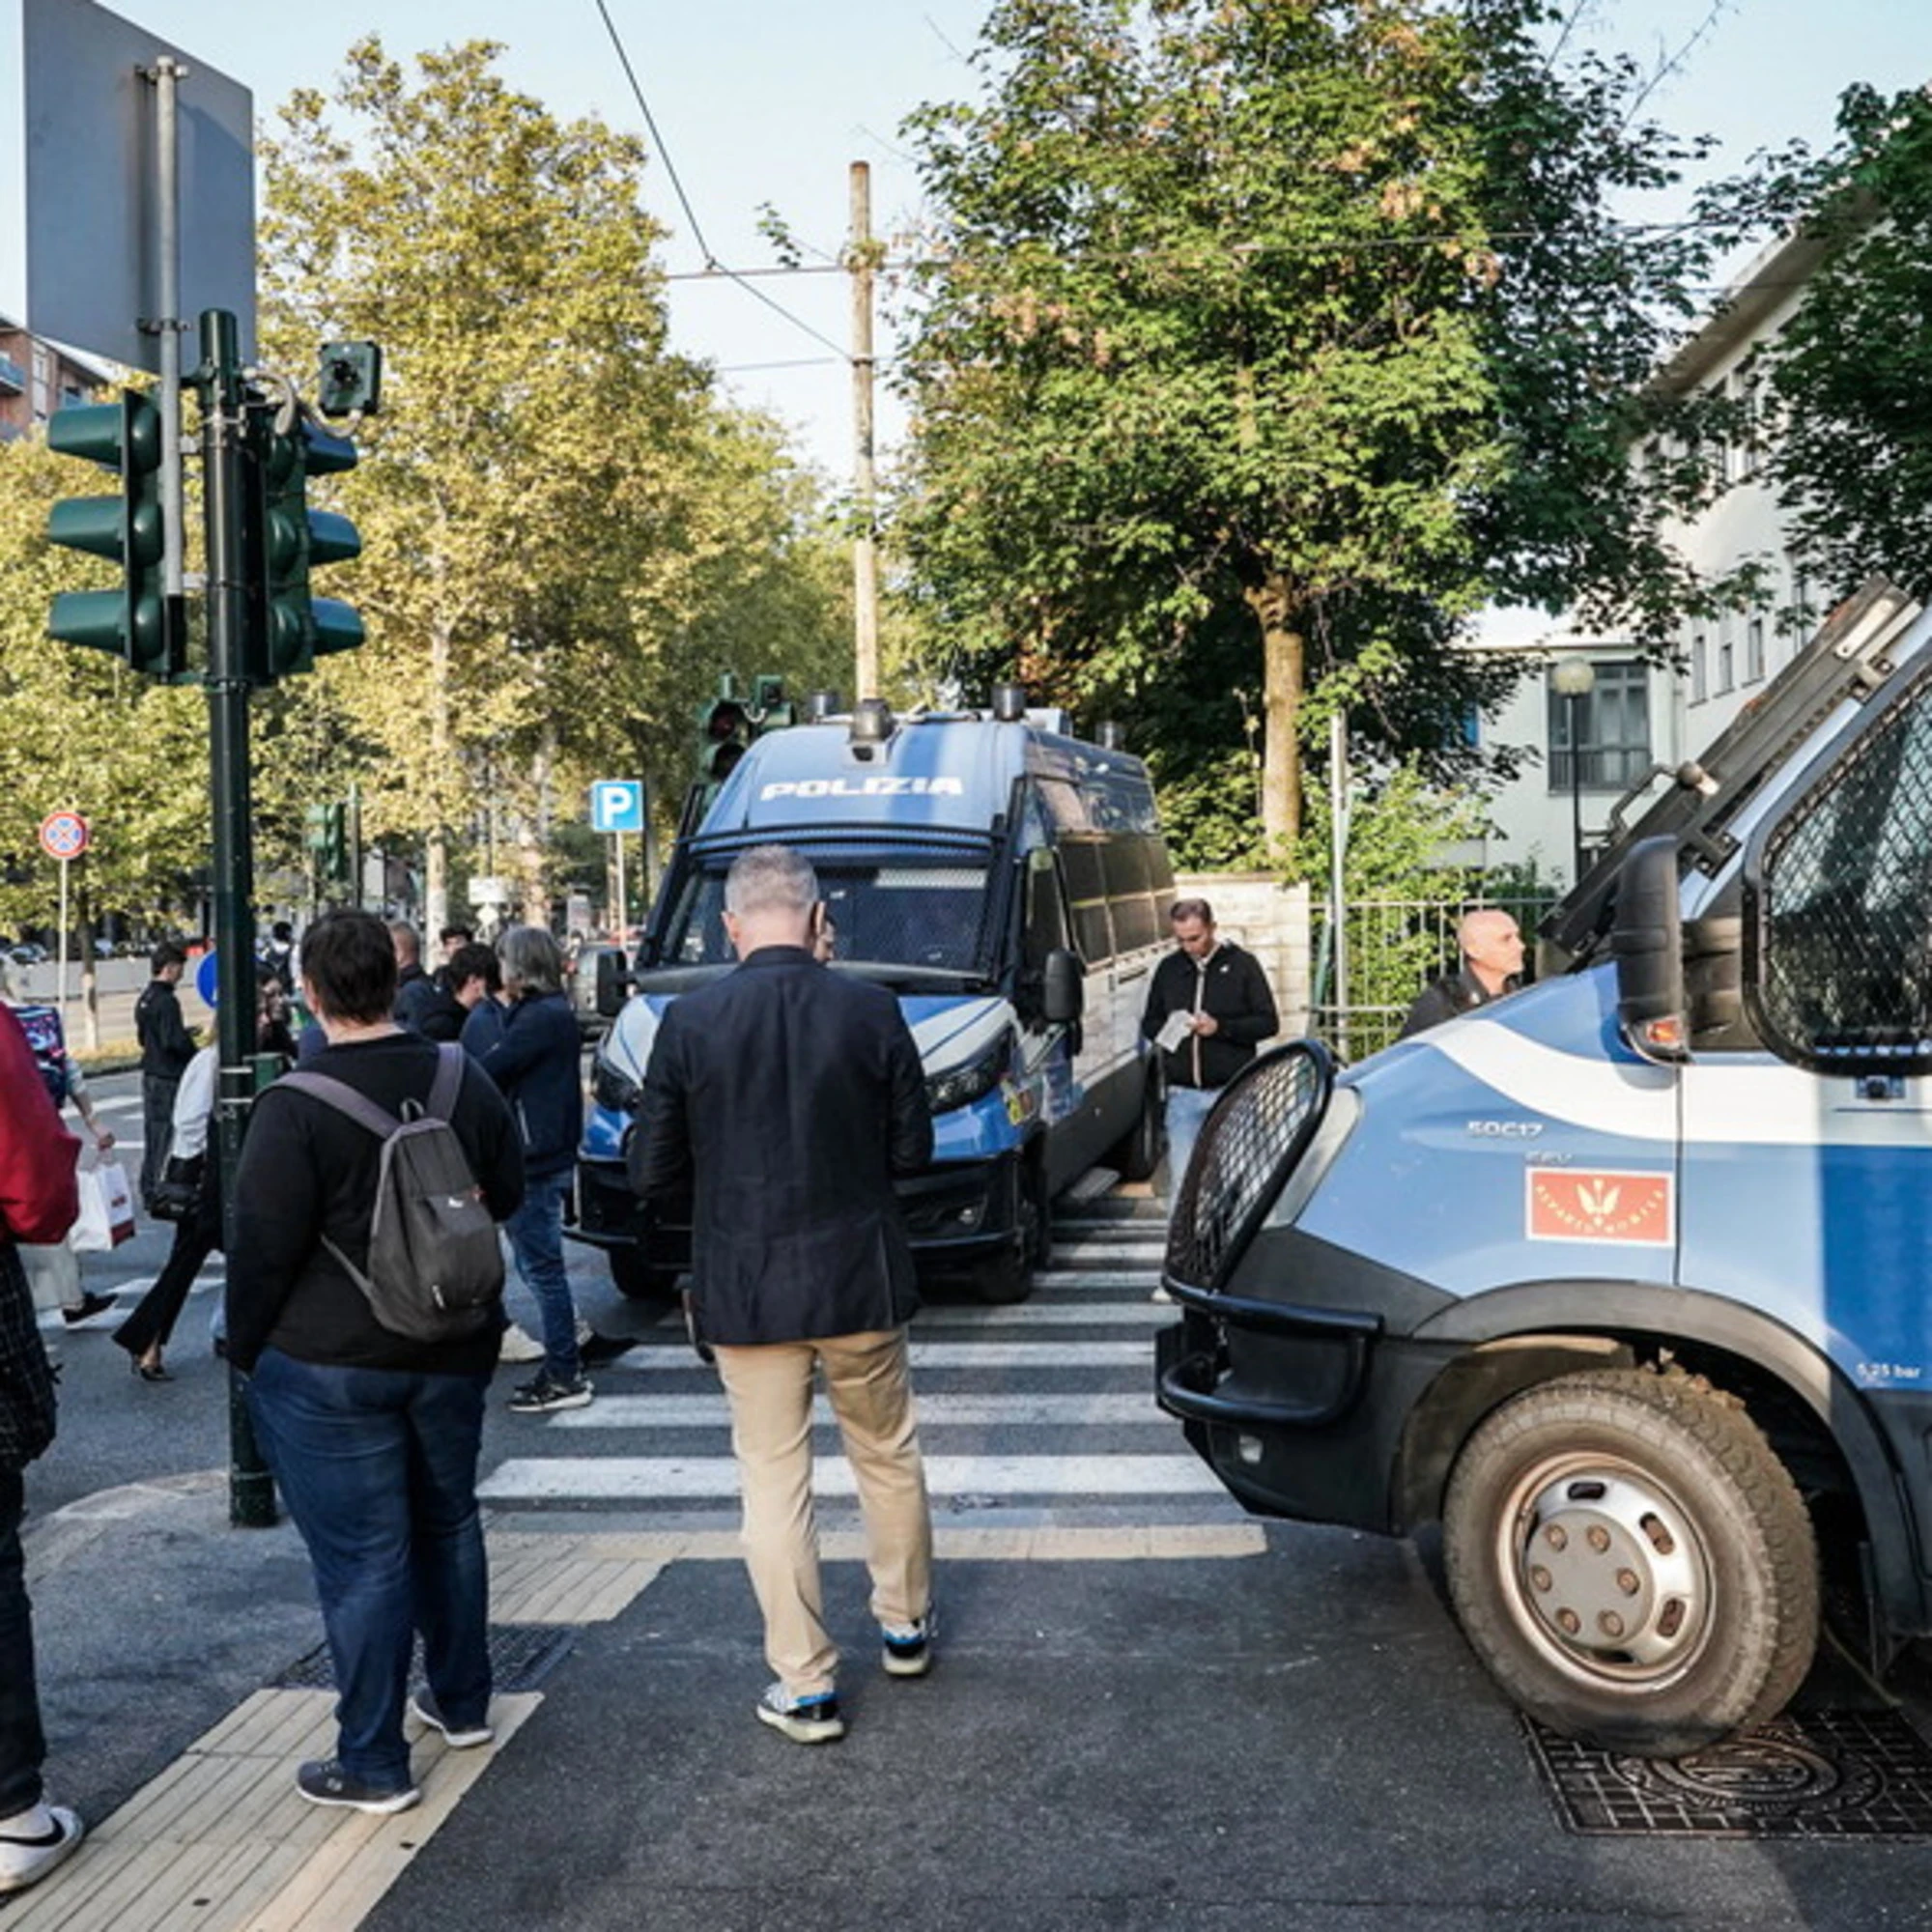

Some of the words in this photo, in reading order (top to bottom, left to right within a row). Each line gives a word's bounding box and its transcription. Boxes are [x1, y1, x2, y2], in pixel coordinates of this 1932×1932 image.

[760, 777, 963, 801] POLIZIA
[602, 786, 634, 828] P
[1894, 1364, 1920, 1378] bar
